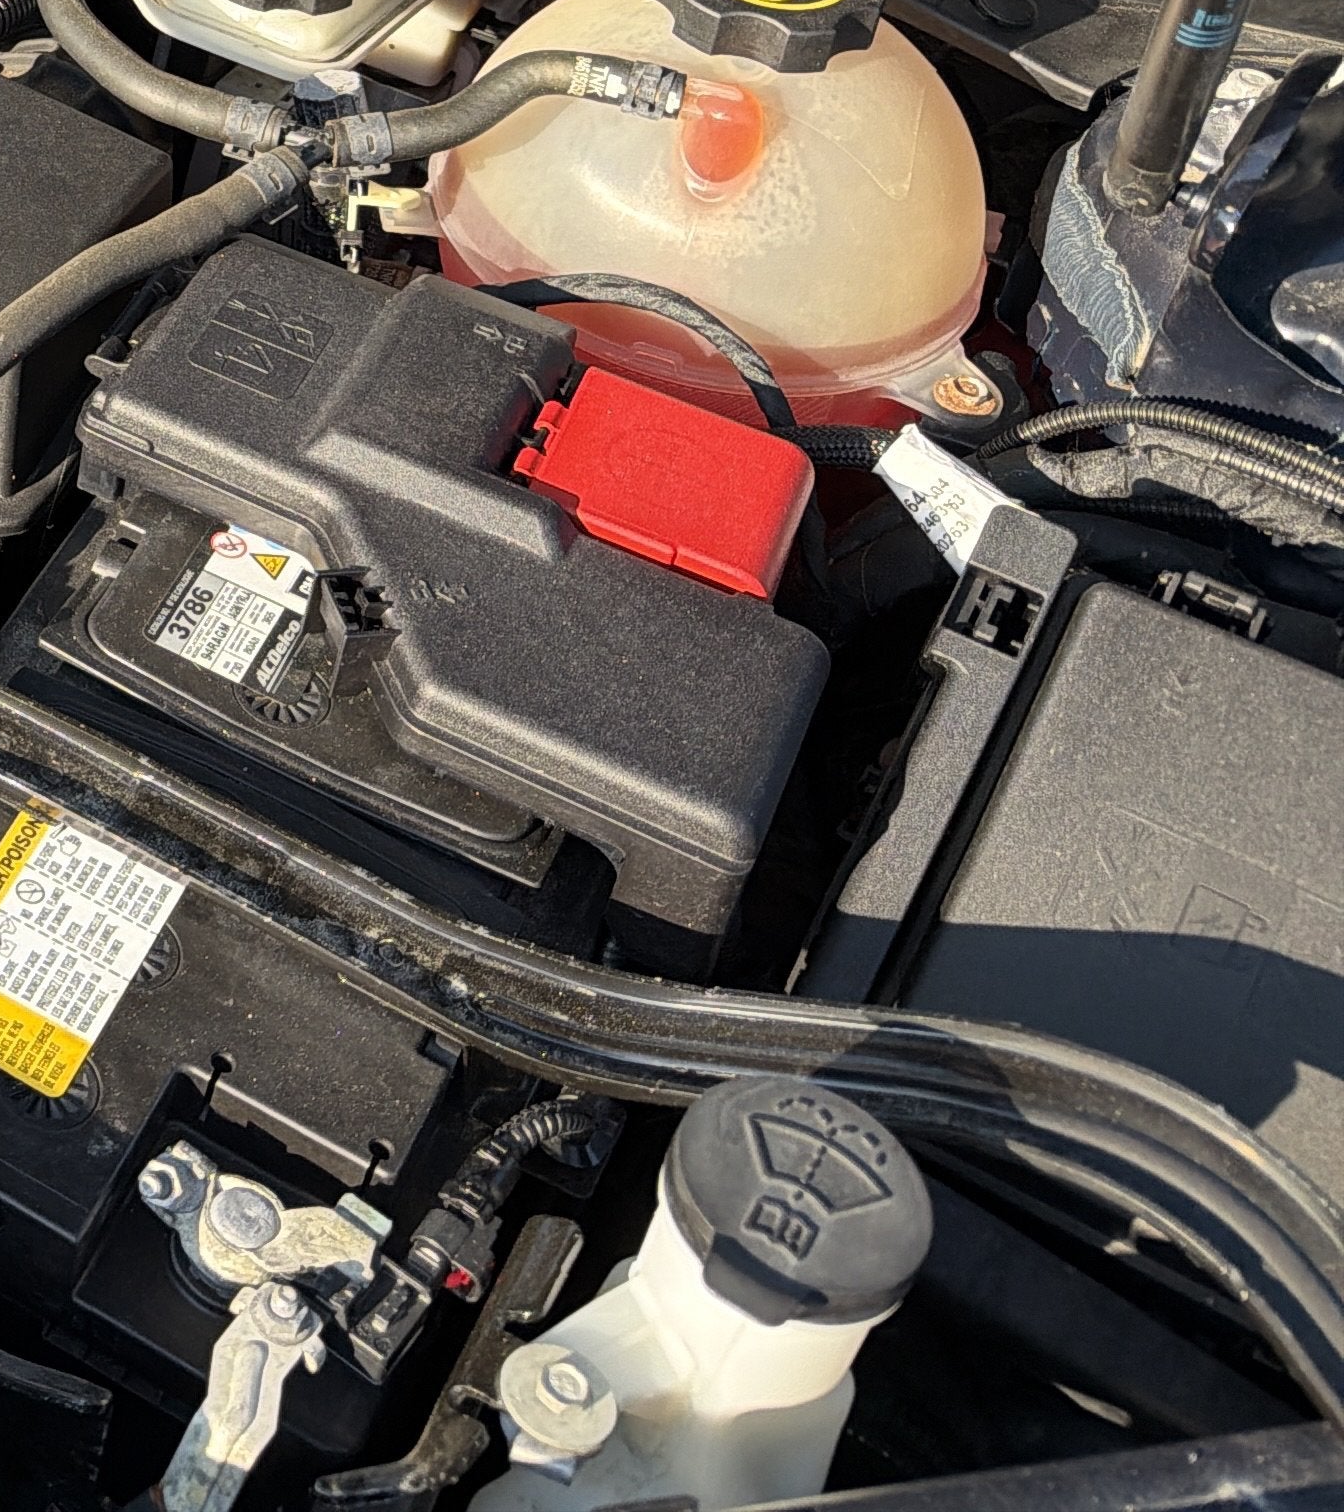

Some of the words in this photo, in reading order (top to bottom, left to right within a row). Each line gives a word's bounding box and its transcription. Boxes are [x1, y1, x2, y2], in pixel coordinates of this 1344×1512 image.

[586, 66, 610, 97] TNK
[168, 587, 214, 640] 3786
[202, 622, 230, 659] 94RAGM
[255, 620, 301, 686] ACDelco
